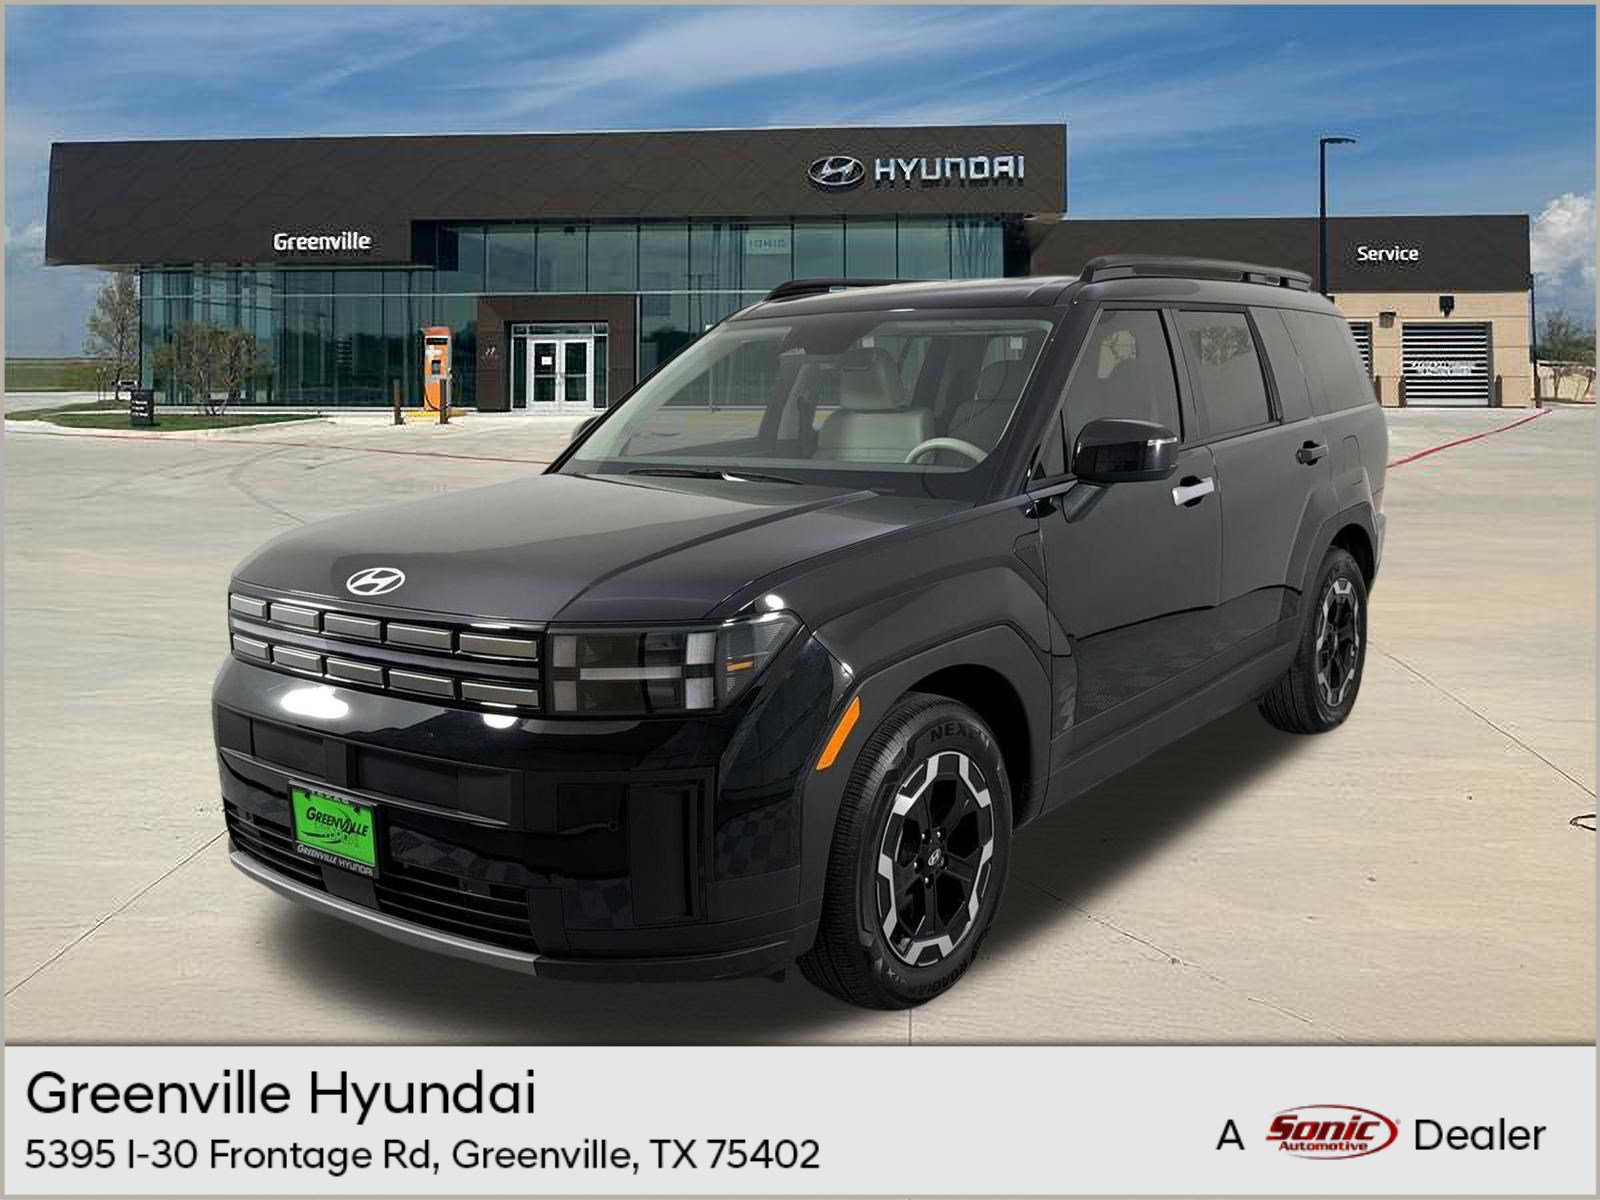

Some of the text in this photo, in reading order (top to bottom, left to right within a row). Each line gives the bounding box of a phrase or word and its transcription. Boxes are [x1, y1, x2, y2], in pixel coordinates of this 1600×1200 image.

[875, 155, 1024, 181] HYUNDAI
[273, 231, 371, 251] Greenville
[1357, 245, 1419, 262] Service
[306, 806, 369, 837] GREENVILLE
[297, 844, 338, 865] GREENVILLE
